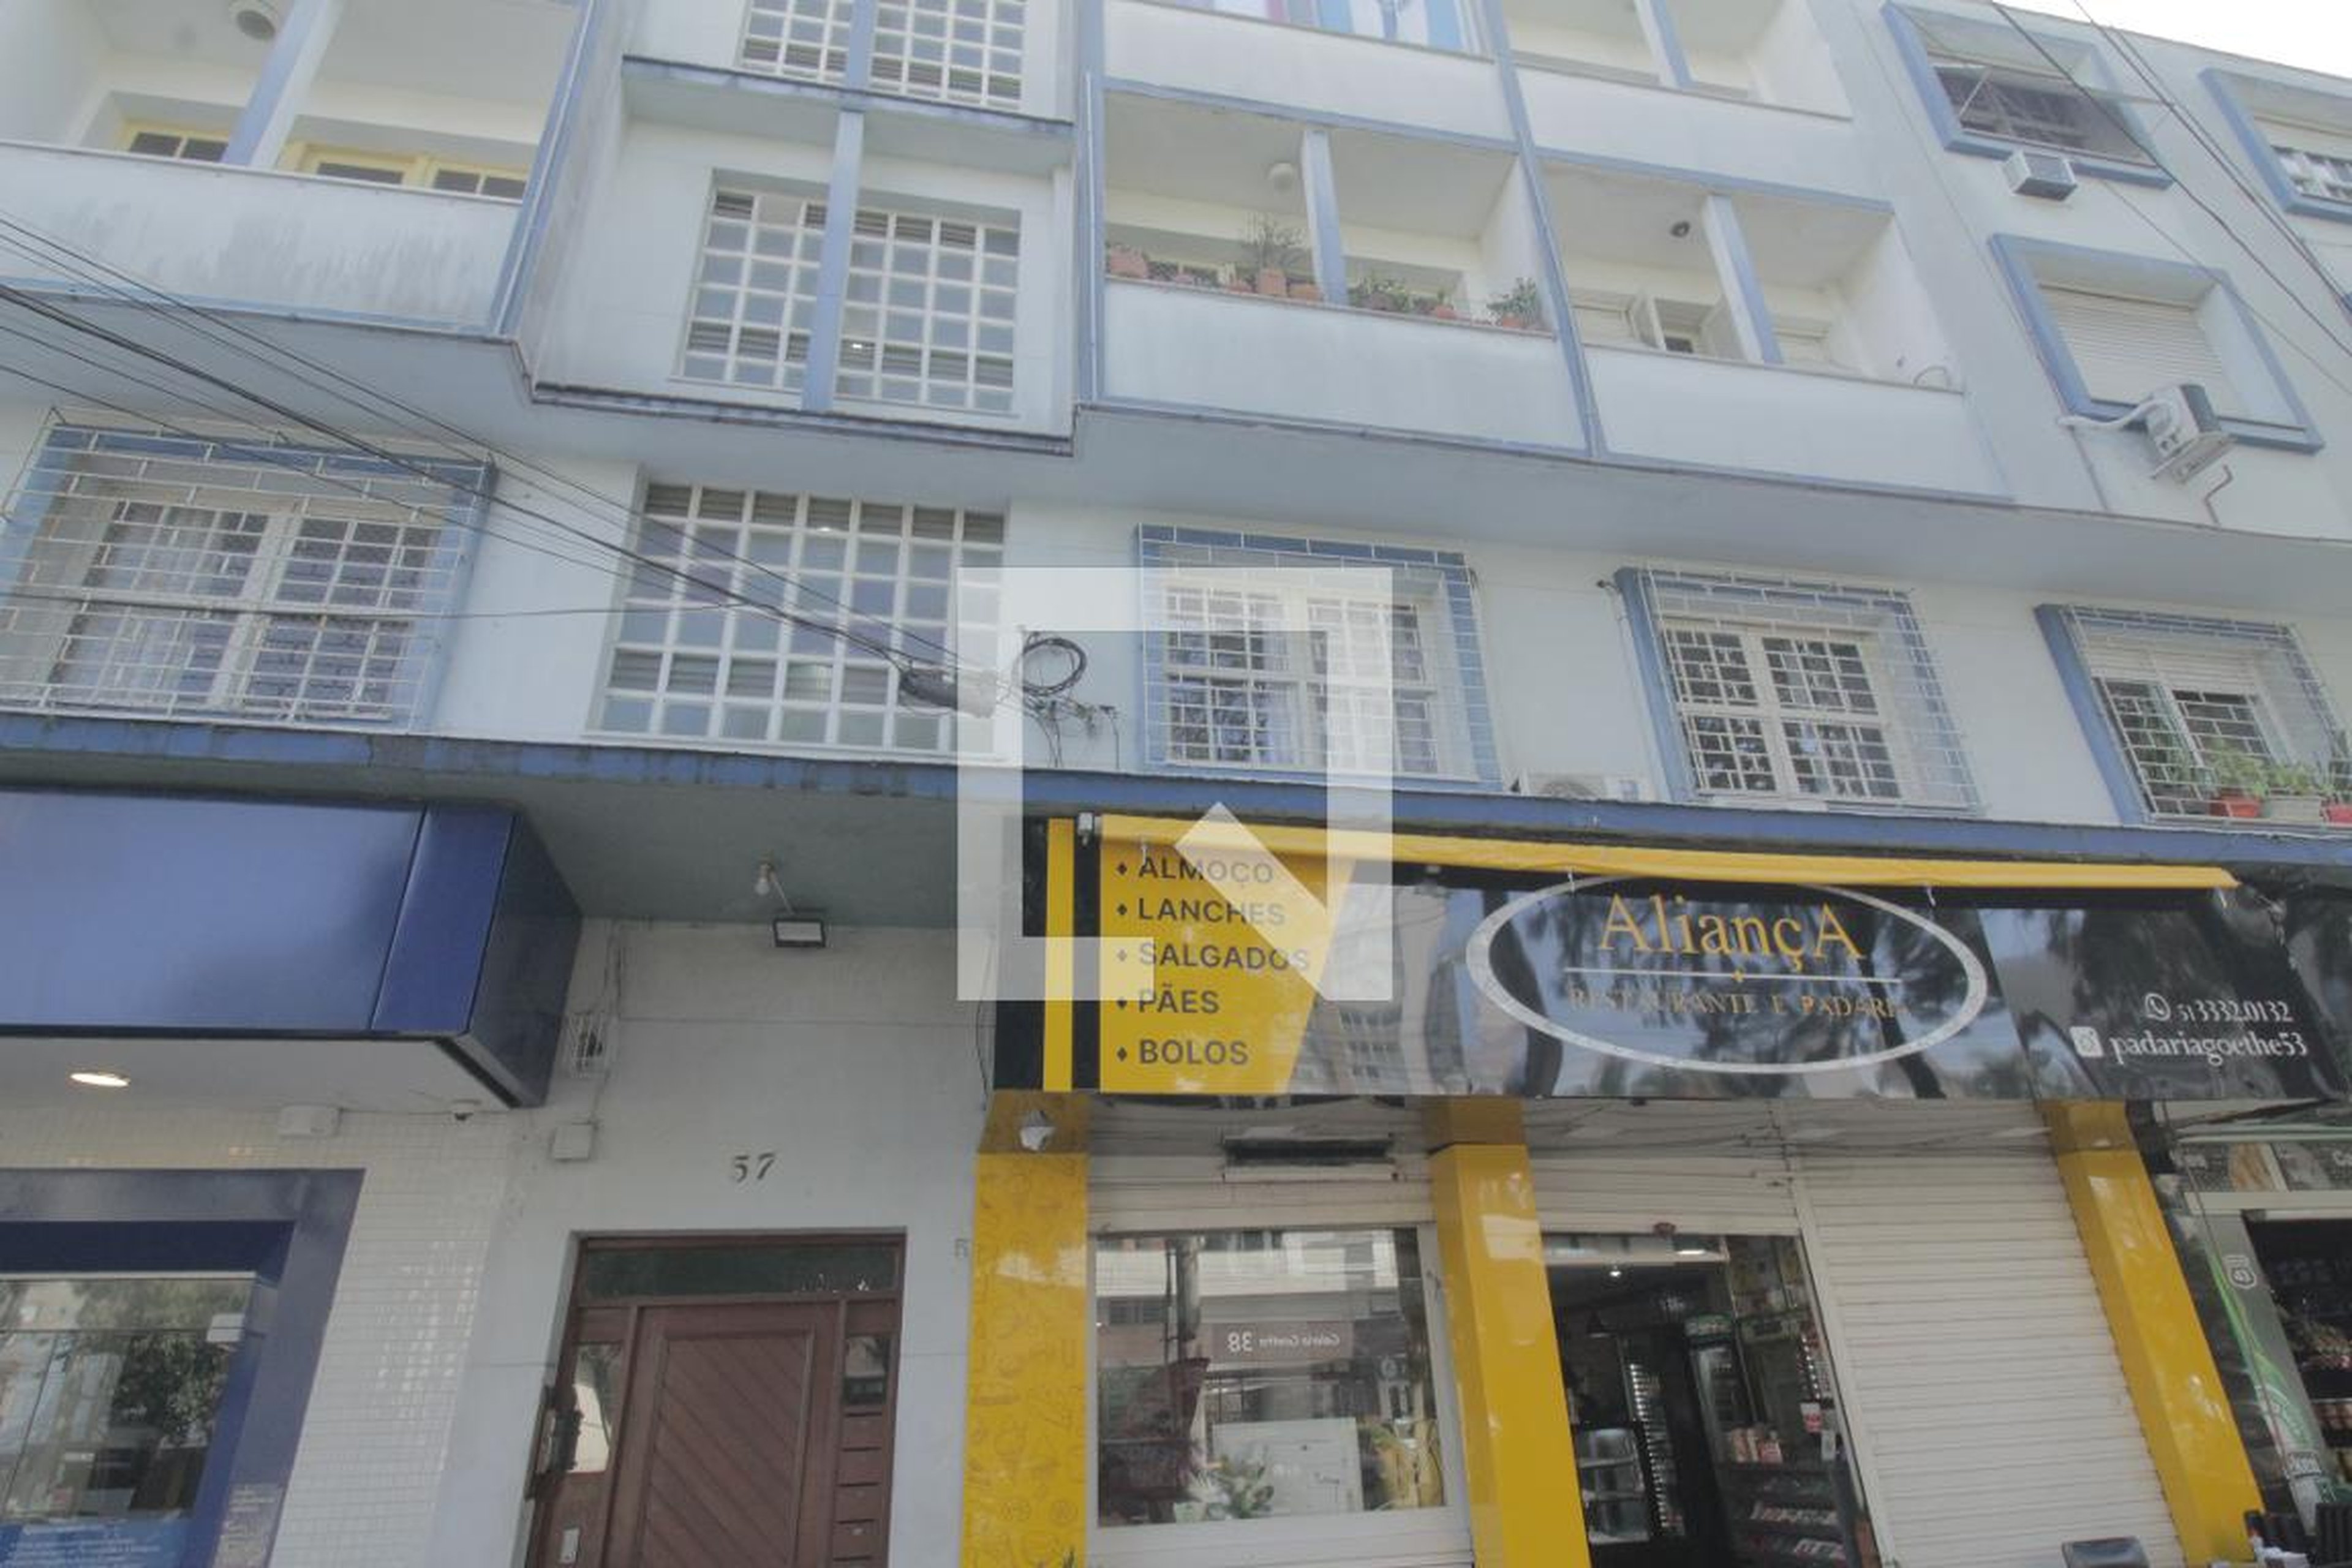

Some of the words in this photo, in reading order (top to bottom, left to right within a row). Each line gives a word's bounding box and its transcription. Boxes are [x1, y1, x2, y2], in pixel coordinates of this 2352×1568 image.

[1138, 897, 1286, 927] LANCHES
[1597, 892, 1867, 973] AliançA
[1139, 942, 1310, 971] SALGADOS
[1139, 983, 1220, 1014] PÃES
[1139, 1039, 1250, 1066] BOLOS
[2110, 1030, 2308, 1066] padariagoethe53
[733, 1152, 776, 1183] 57
